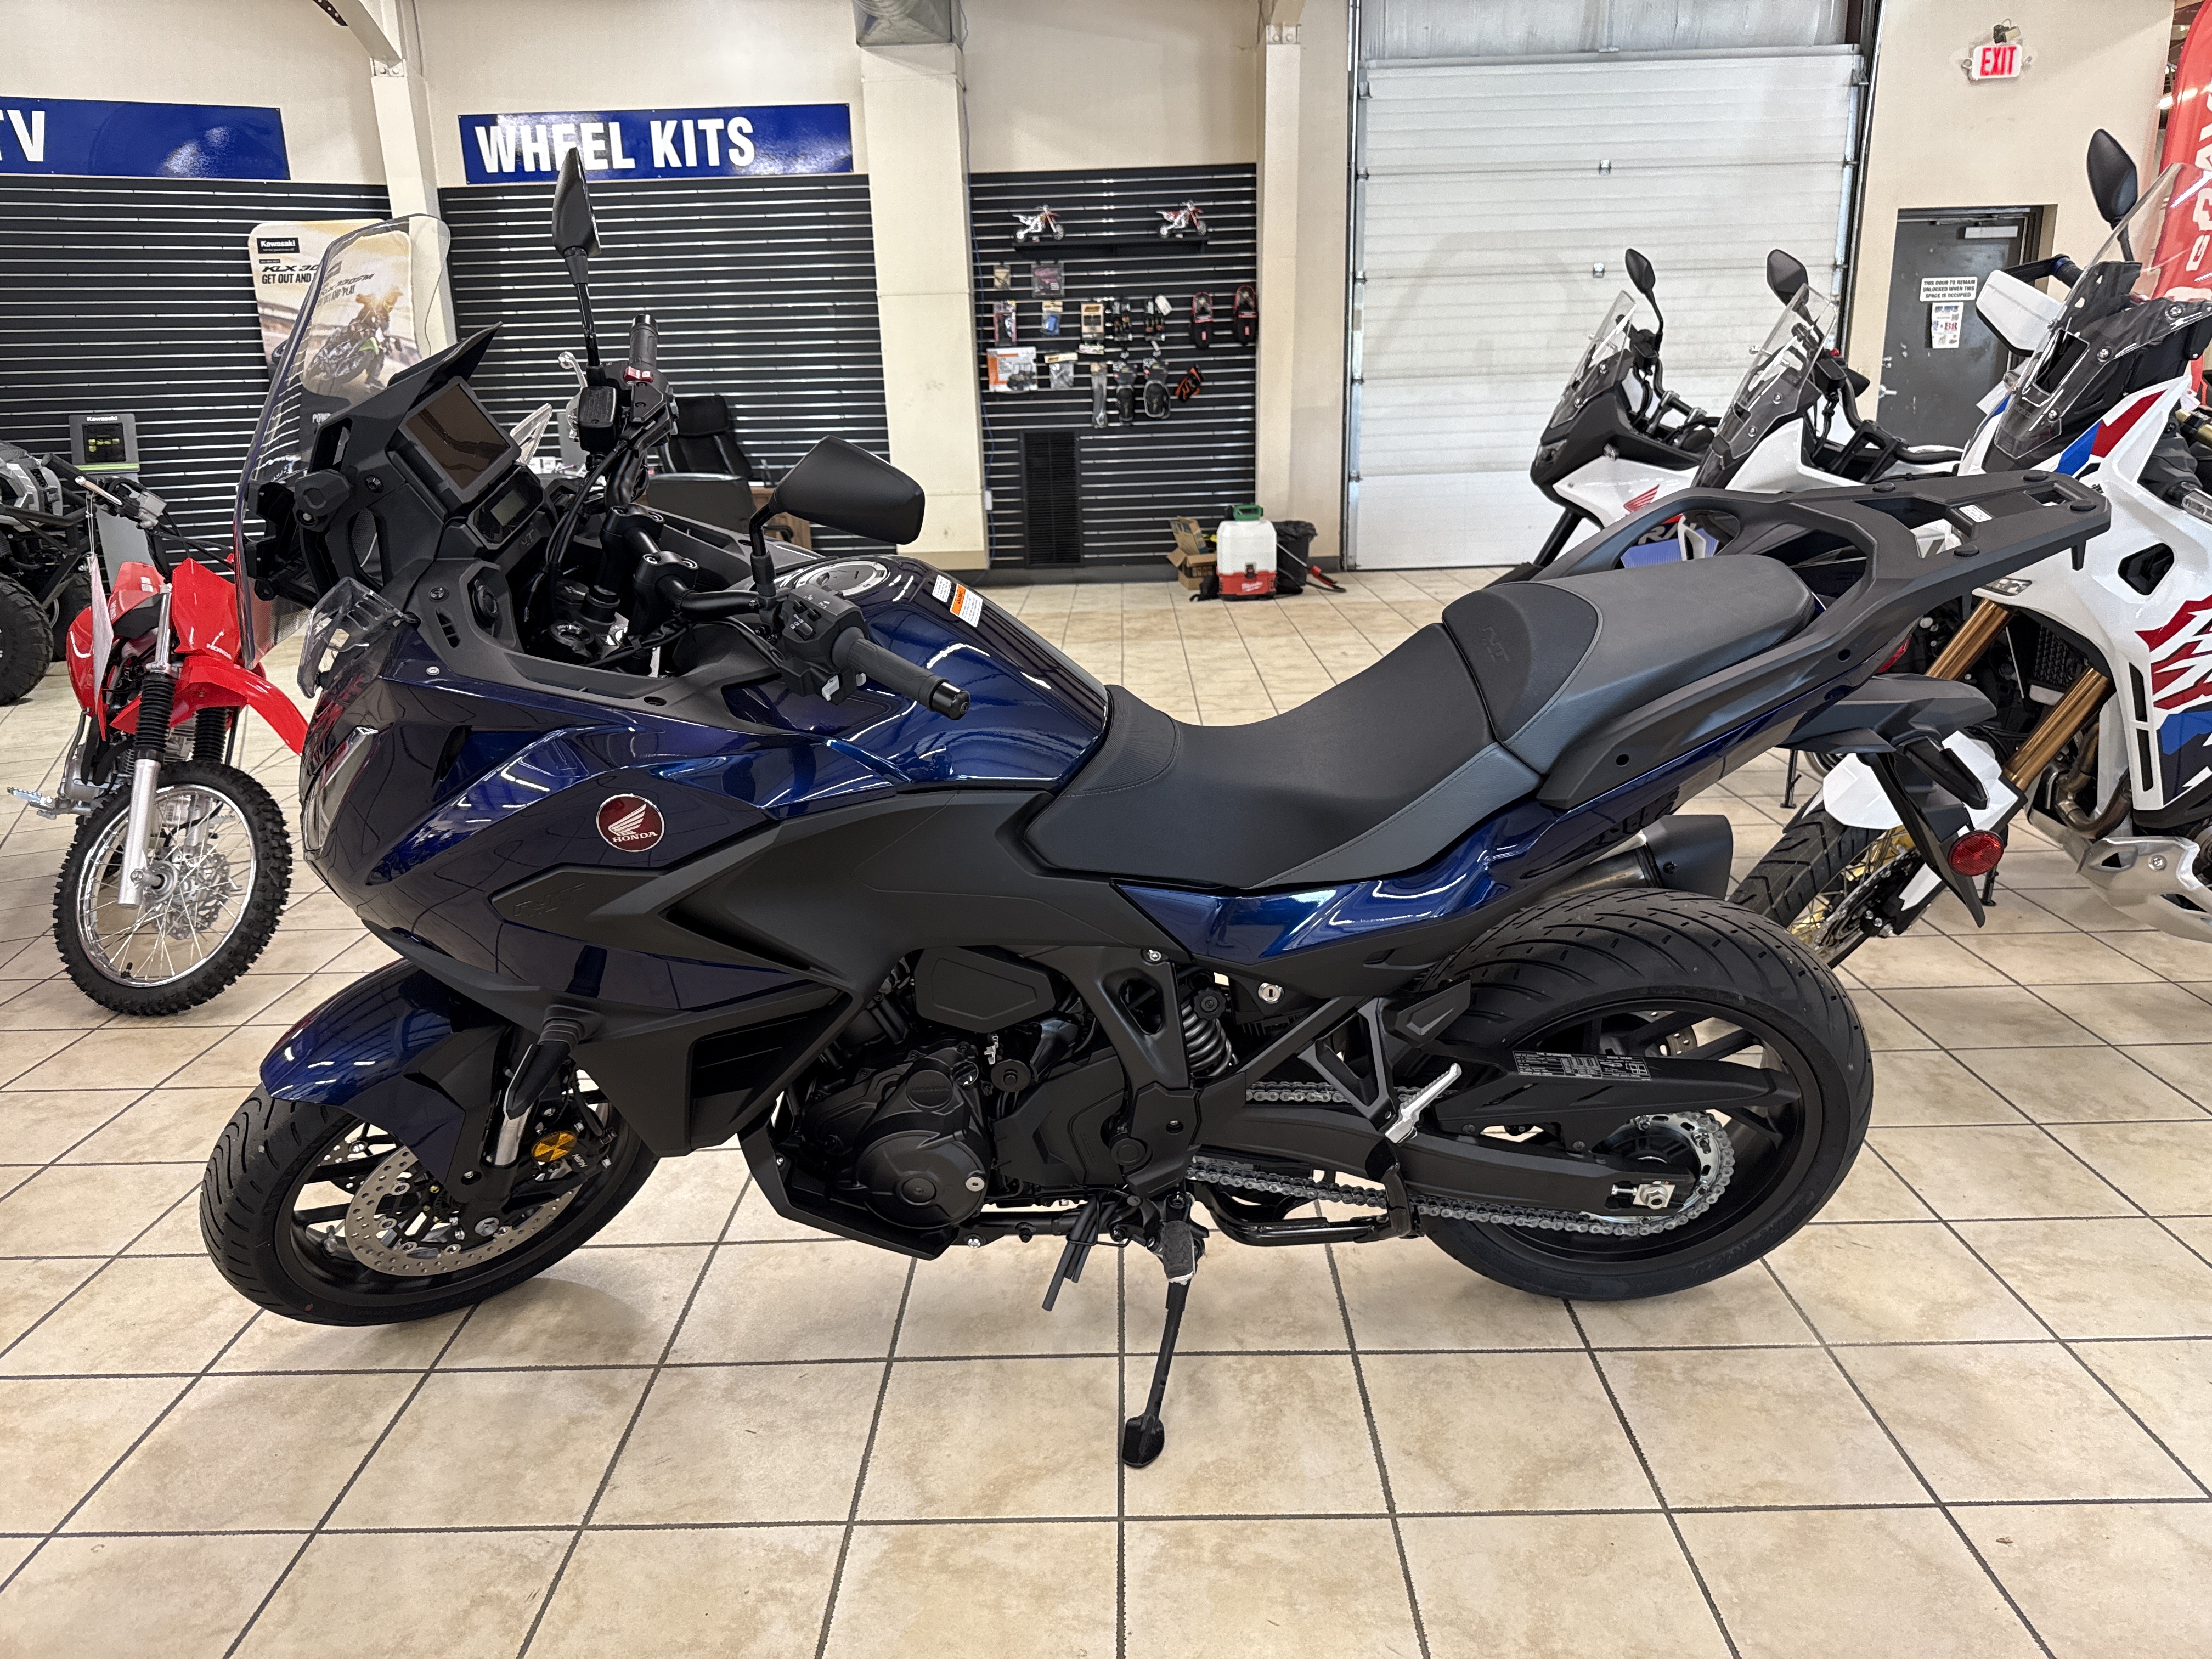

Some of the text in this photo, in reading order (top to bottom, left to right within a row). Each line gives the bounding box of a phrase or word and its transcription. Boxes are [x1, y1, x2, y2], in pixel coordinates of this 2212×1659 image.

[1980, 46, 2017, 76] EXIT
[0, 109, 45, 162] V
[475, 117, 755, 173] WHEEL KITS
[262, 273, 311, 284] GET OUT AND
[206, 643, 232, 660] HONDA
[612, 831, 658, 843] HONDA
